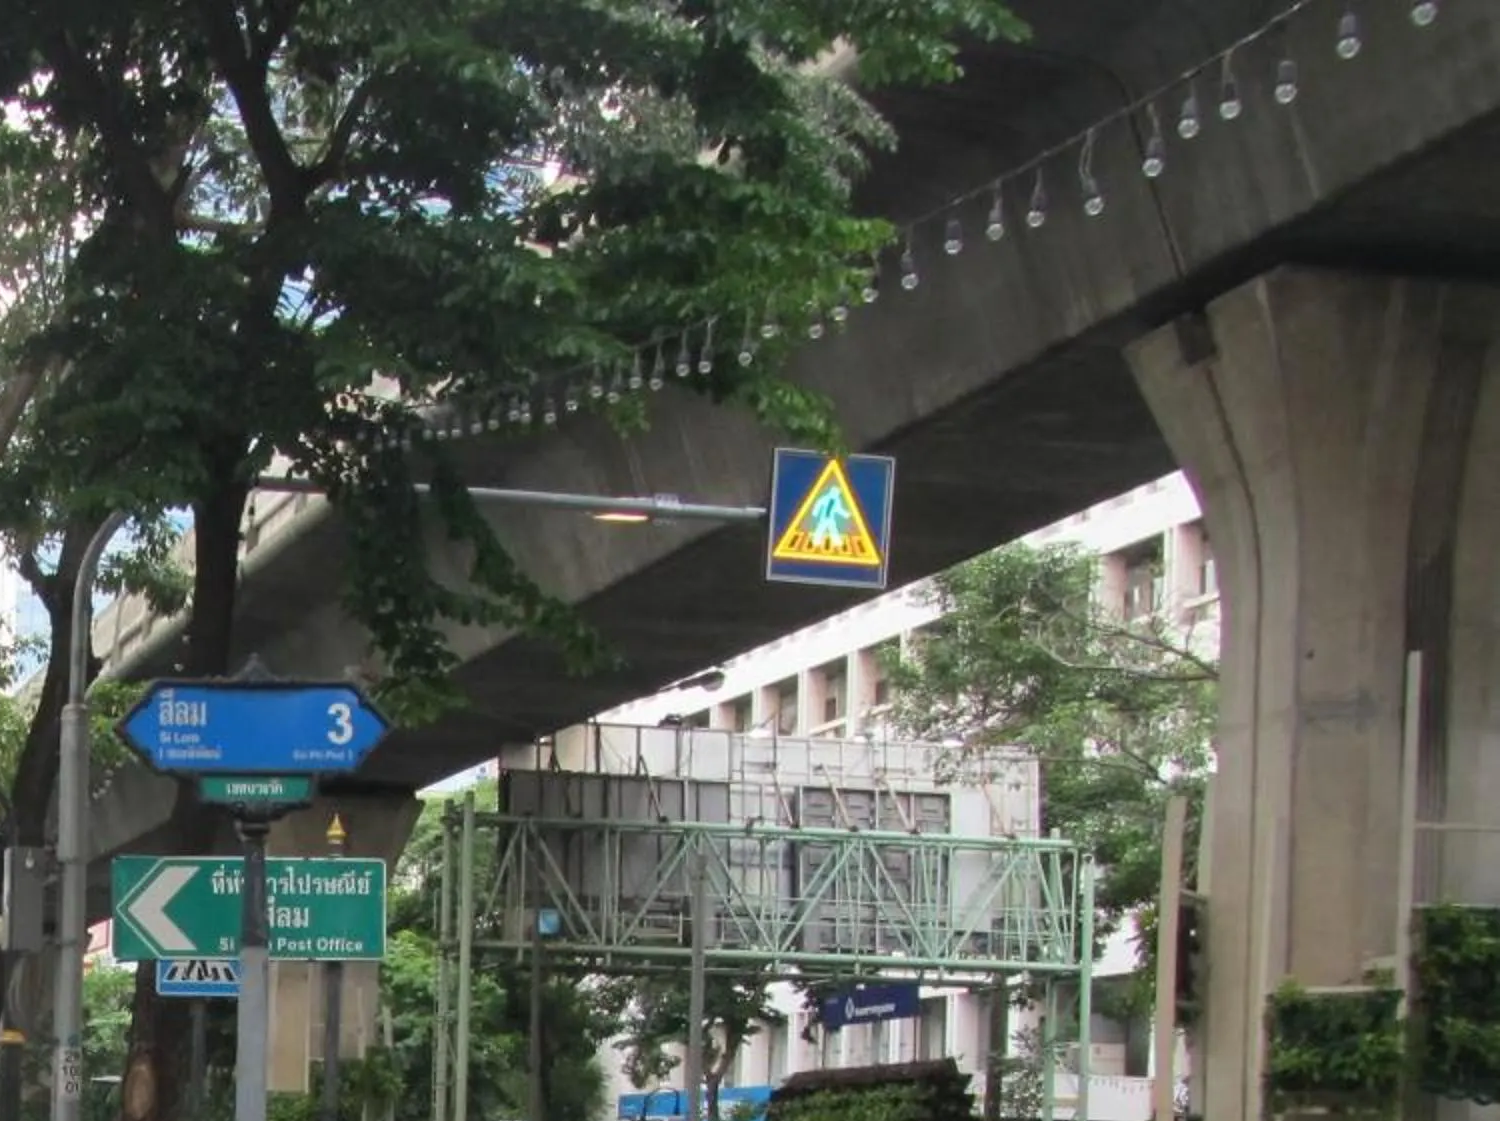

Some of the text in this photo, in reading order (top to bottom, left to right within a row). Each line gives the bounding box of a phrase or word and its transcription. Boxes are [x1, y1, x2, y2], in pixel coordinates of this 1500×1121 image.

[159, 688, 207, 727] สีลม
[327, 703, 353, 745] 3
[277, 937, 313, 951] Post
[316, 937, 364, 952] Office
